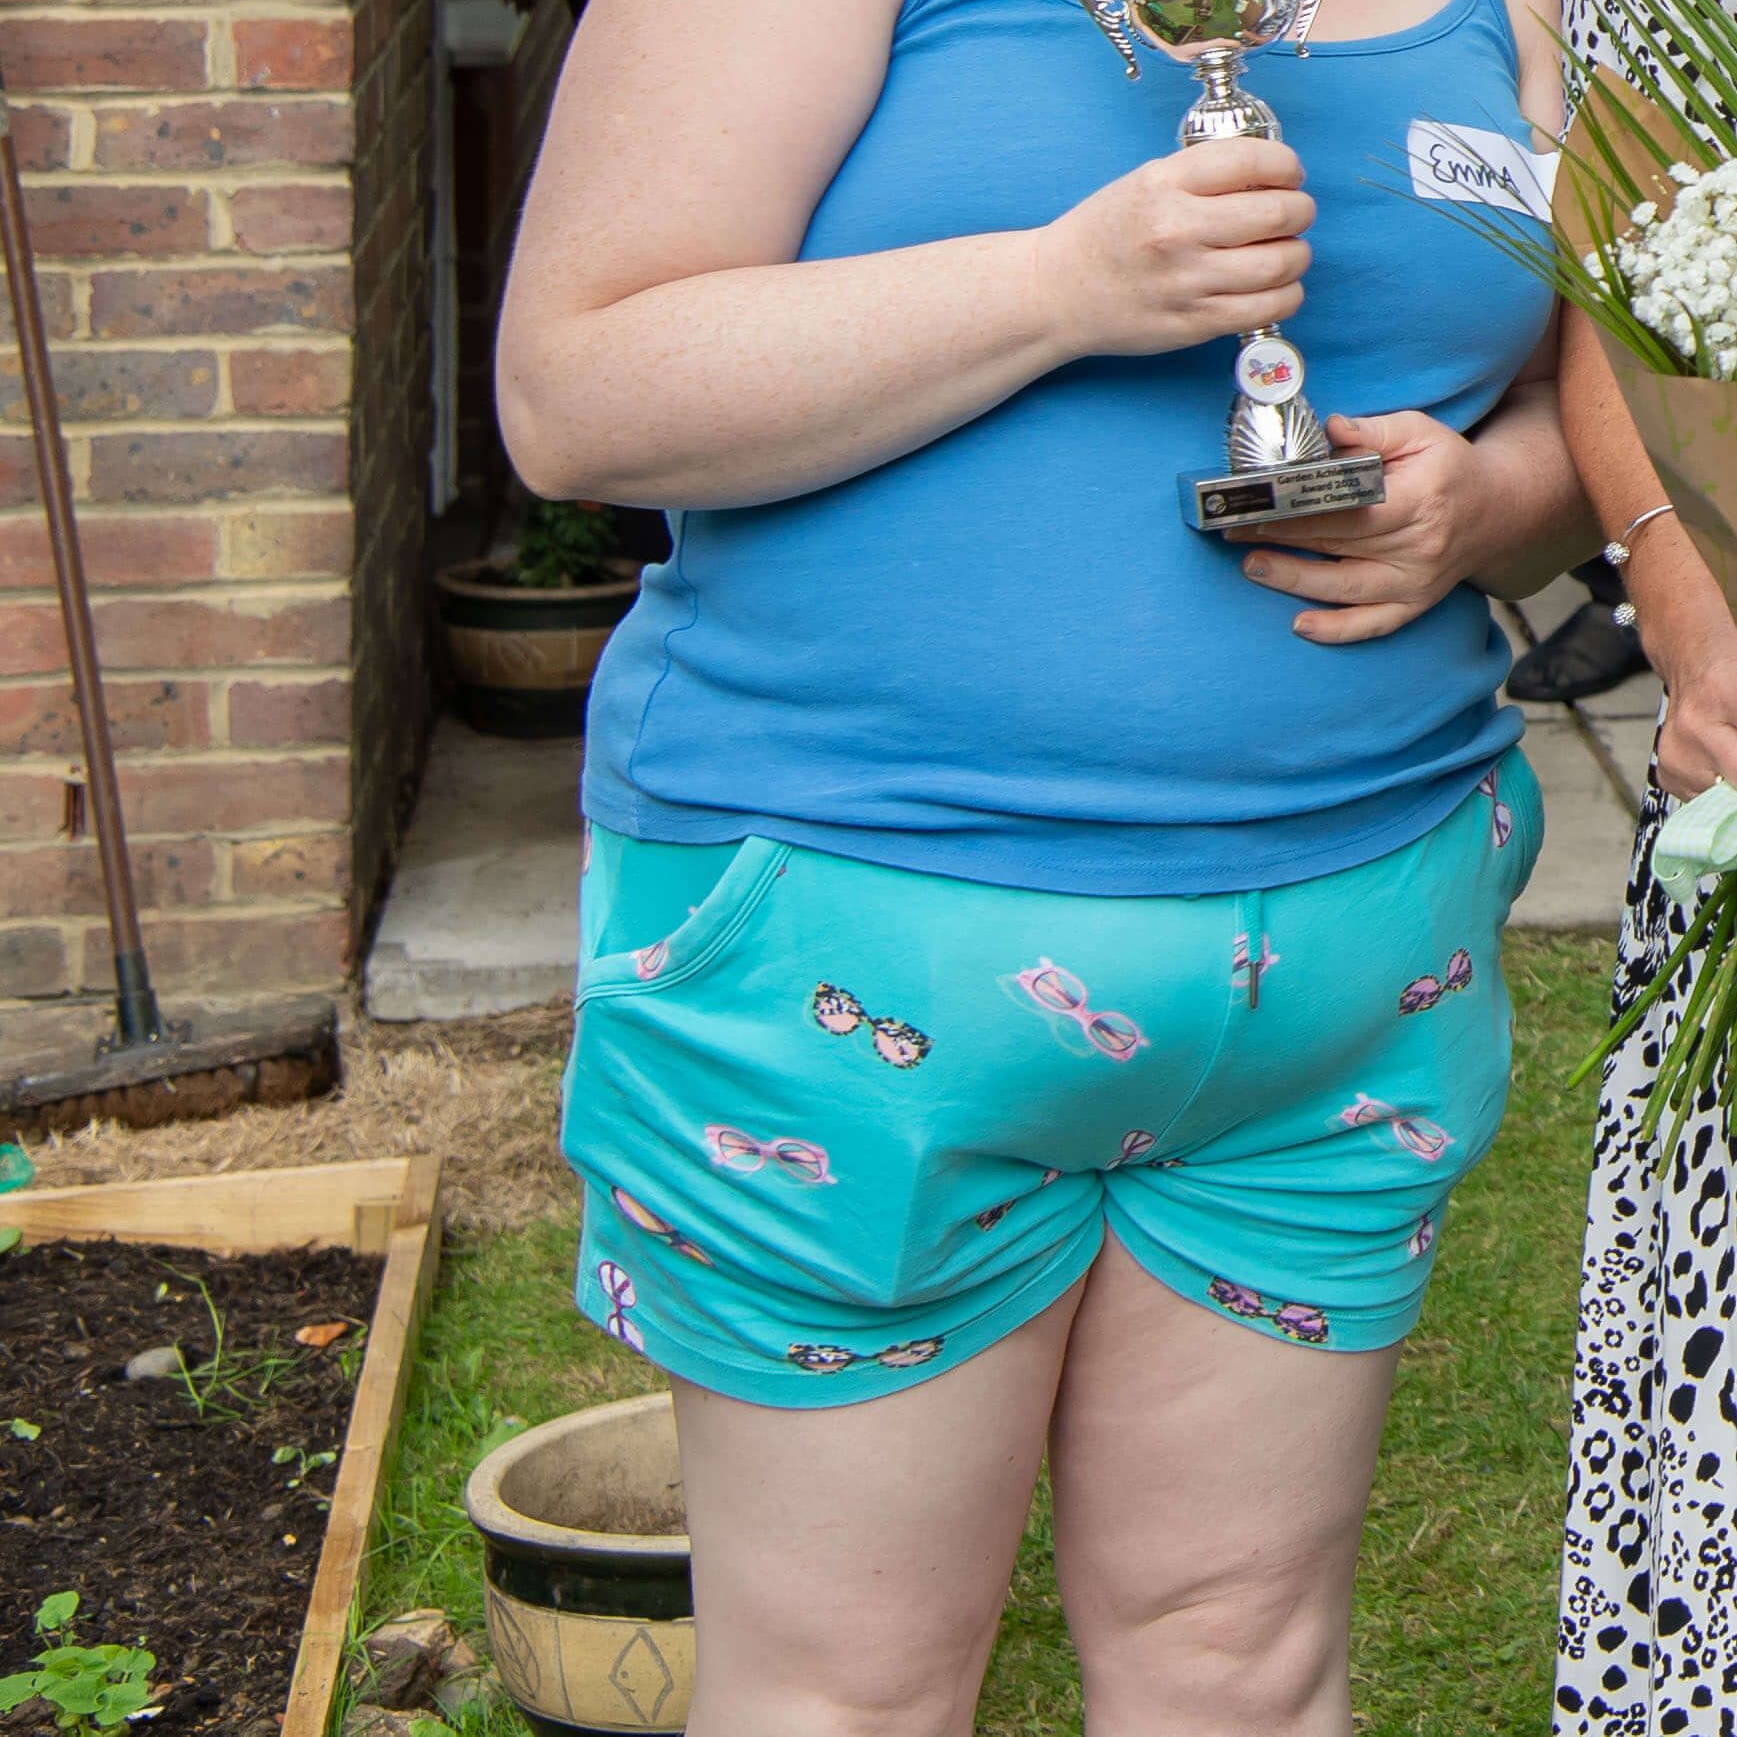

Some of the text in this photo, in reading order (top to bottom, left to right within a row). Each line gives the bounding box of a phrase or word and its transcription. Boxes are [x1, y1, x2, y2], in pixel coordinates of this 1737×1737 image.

[1277, 472, 1314, 484] Garden
[1301, 481, 1333, 493] Award
[1290, 488, 1376, 508] Emma Champion
